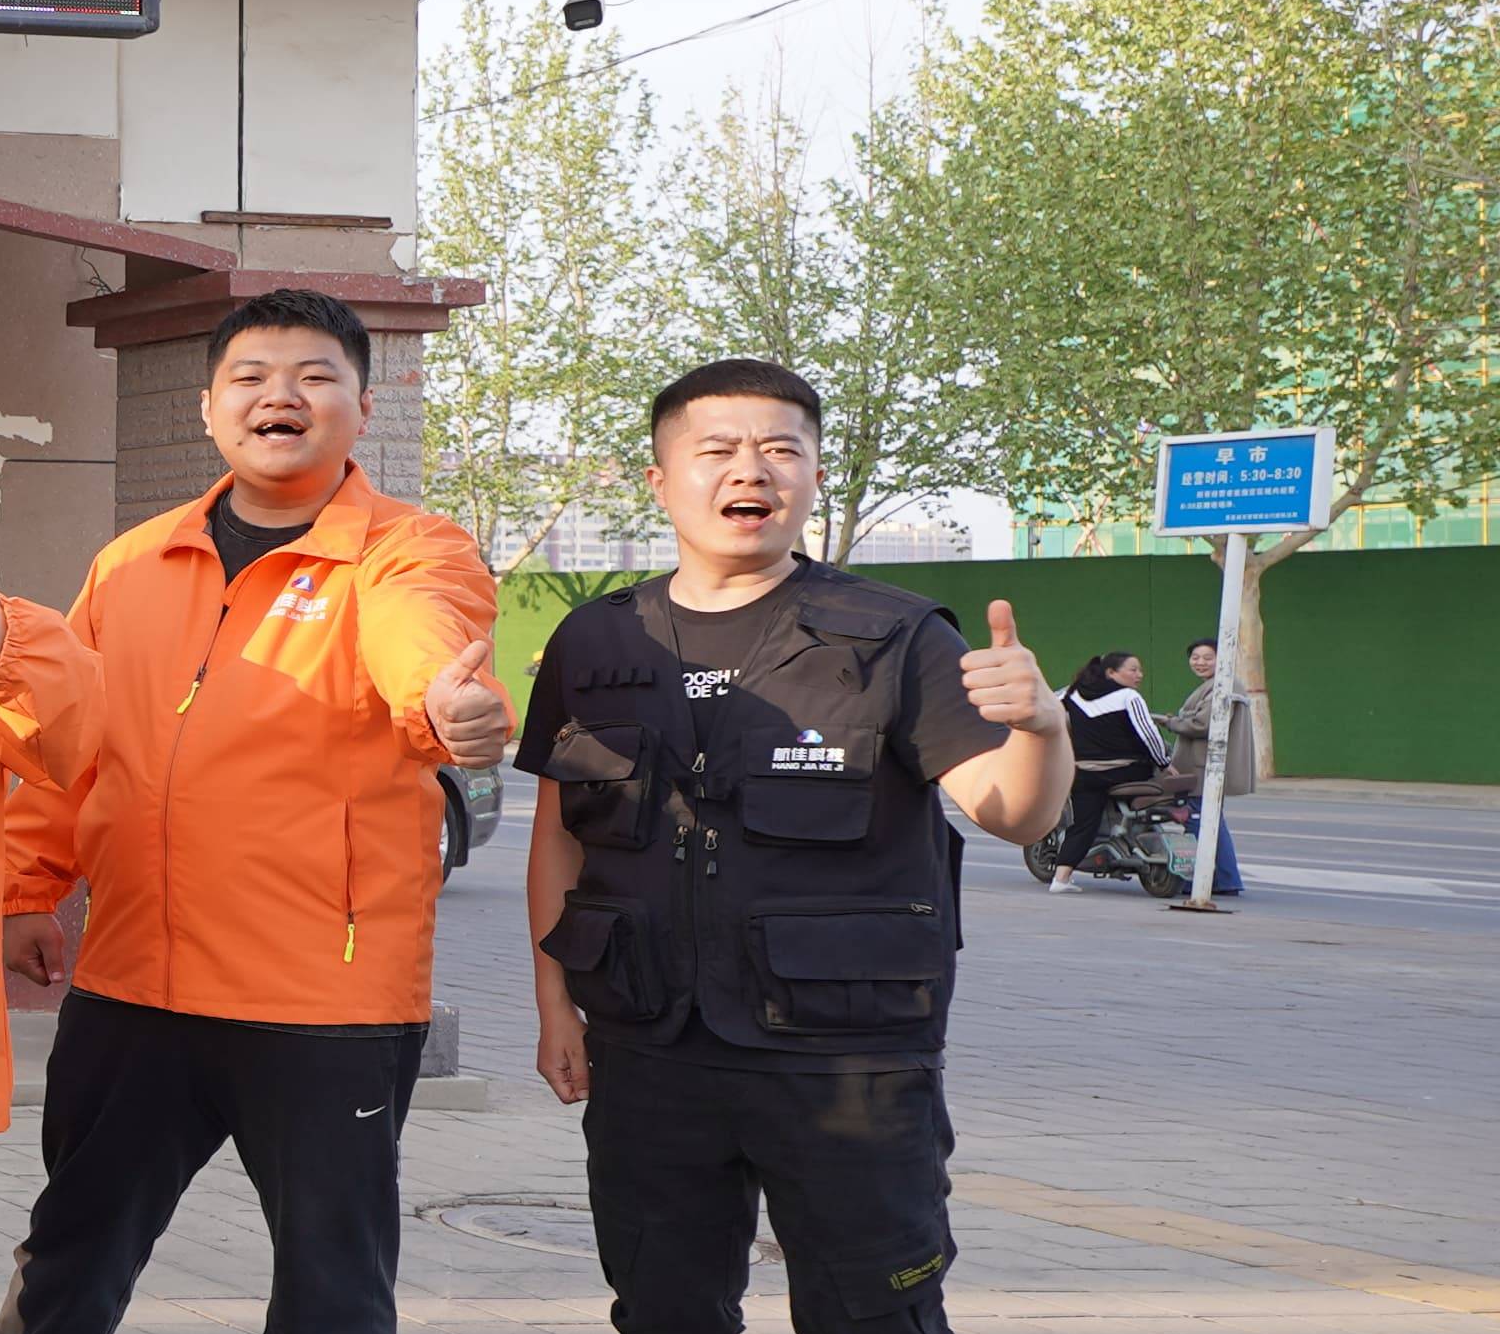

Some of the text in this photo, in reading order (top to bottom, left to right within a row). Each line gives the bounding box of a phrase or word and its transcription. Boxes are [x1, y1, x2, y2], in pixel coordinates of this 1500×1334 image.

[1215, 445, 1269, 465] 早市
[772, 747, 845, 763] 航佳科技
[771, 762, 800, 771] HANG
[802, 762, 818, 771] JIA
